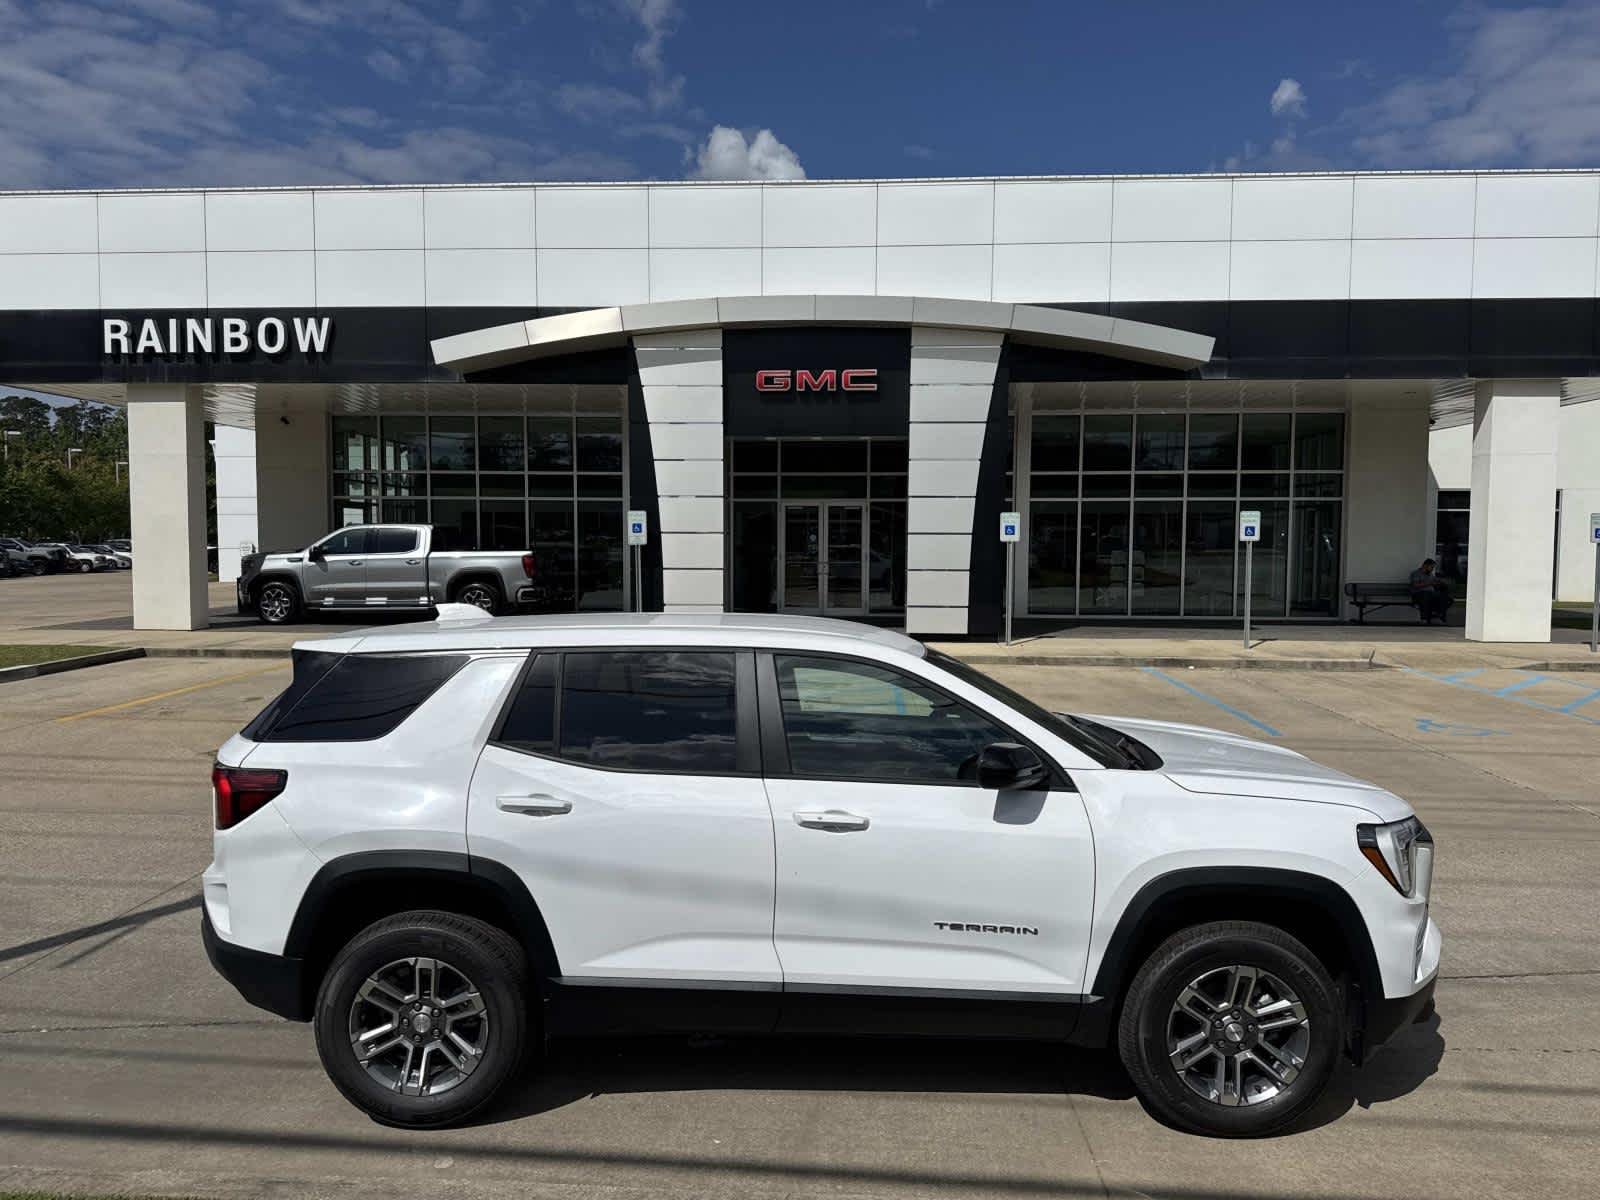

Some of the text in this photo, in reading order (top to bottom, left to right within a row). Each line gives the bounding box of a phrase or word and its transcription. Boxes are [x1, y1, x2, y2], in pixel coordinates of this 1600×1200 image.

[103, 317, 330, 354] RAINBOW
[755, 368, 878, 392] GMC
[933, 922, 1039, 936] TERRAIN
